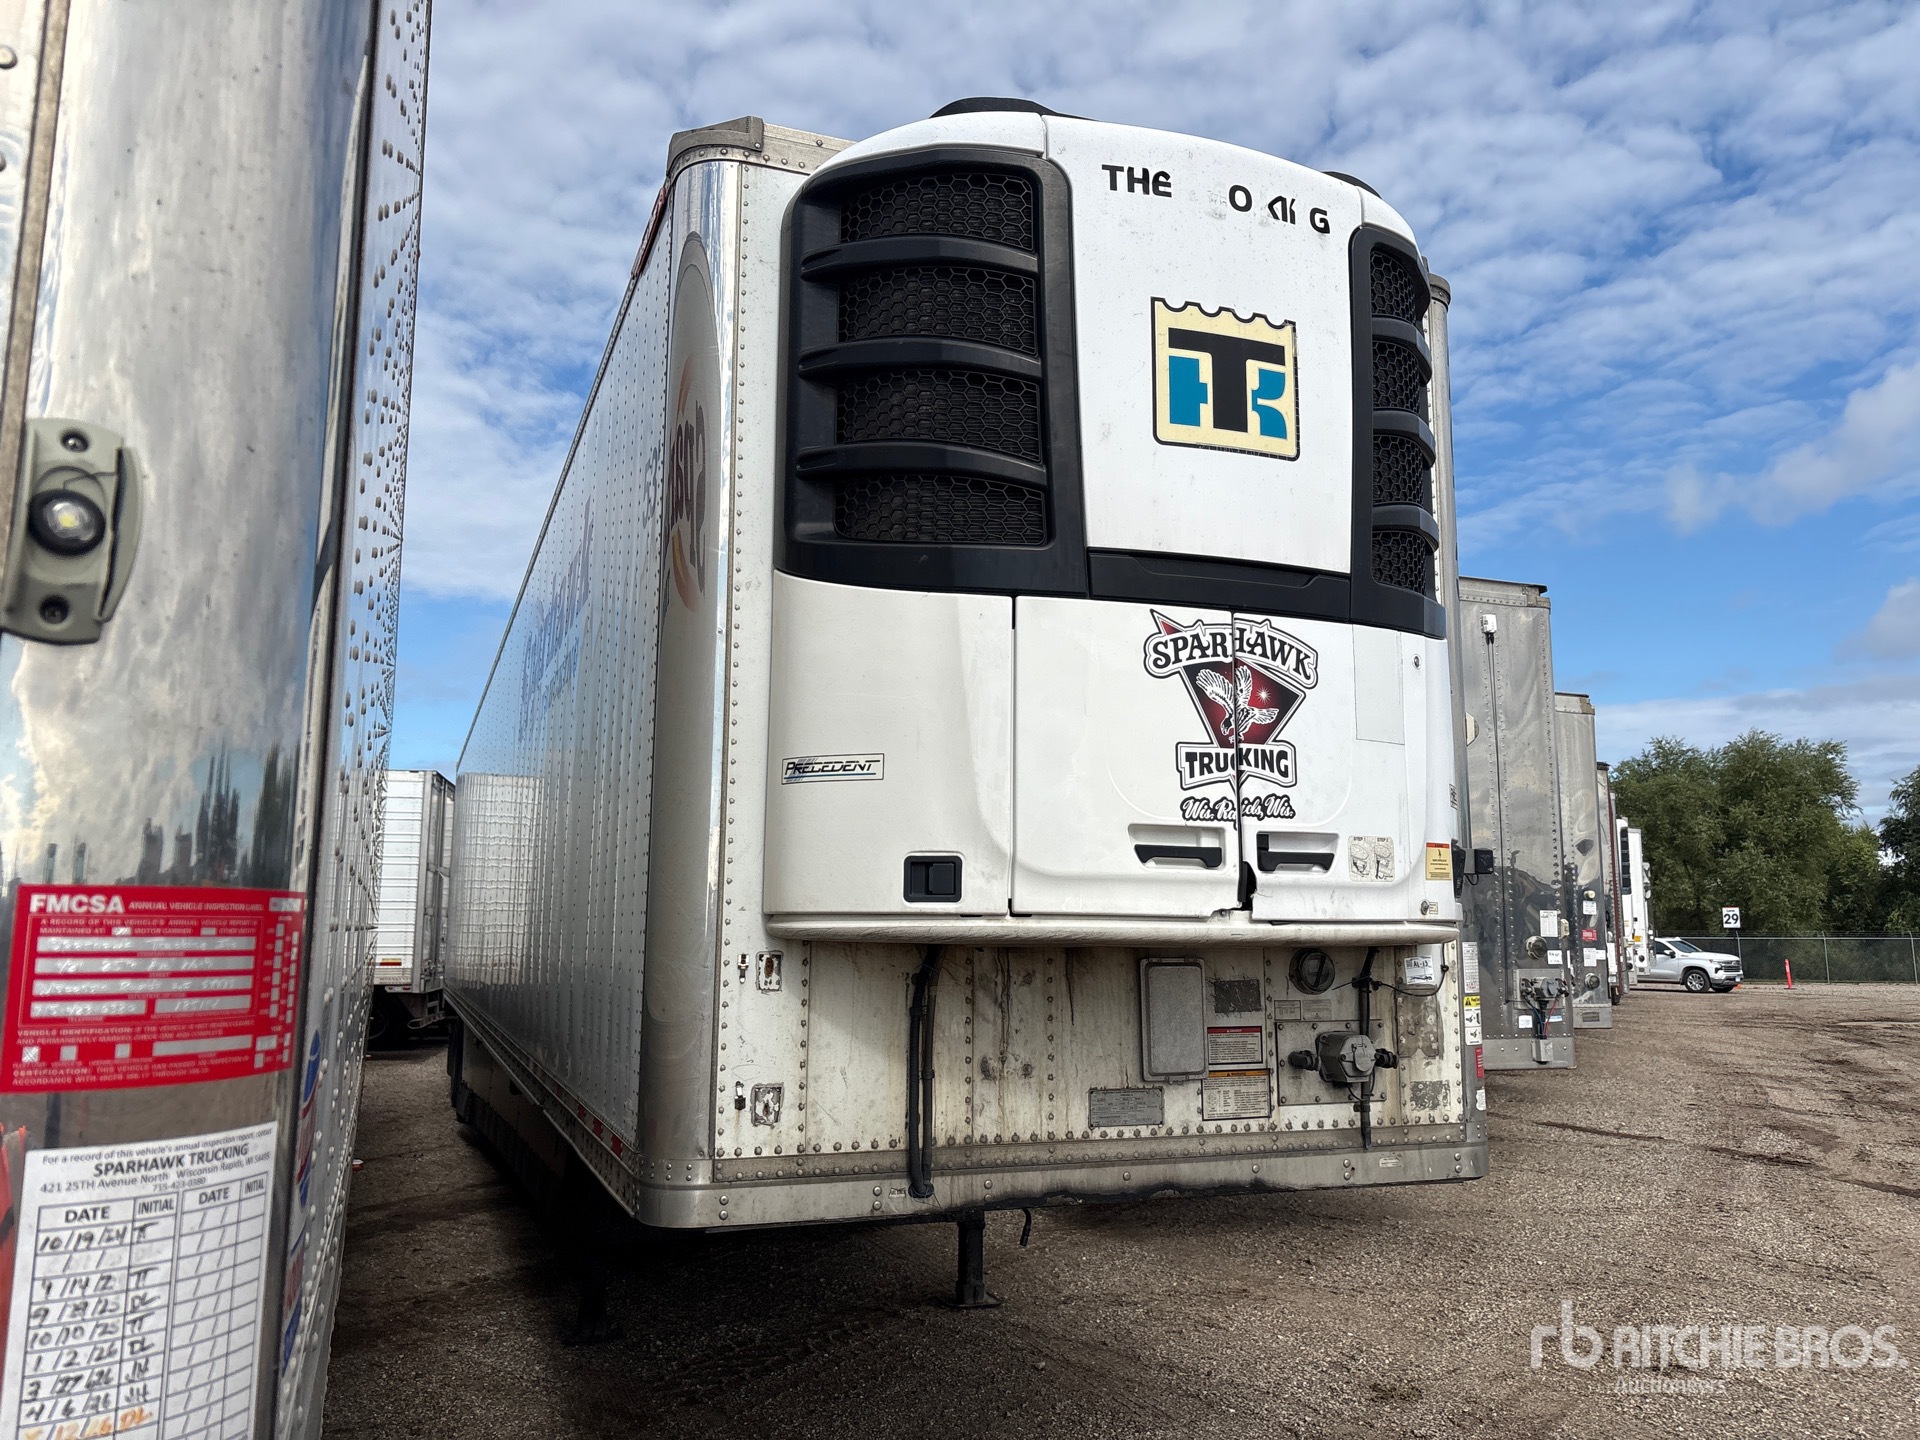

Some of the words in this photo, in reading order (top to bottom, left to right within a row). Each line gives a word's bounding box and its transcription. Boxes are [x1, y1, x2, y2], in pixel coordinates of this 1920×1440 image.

[1152, 626, 1311, 681] SPARHAWK
[785, 760, 881, 776] PRECEDENT
[1185, 747, 1289, 780] TRUCKING
[1182, 798, 1214, 821] Wis.
[1215, 797, 1263, 823] Raids,
[1264, 795, 1296, 818] Wis.
[29, 893, 125, 914] FMCSA
[128, 902, 167, 911] ANNUAL
[169, 902, 202, 911] VEHICLE
[1724, 913, 1739, 925] 29
[42, 1155, 59, 1164] For
[70, 1152, 103, 1162] record
[104, 1150, 115, 1159] of
[117, 1149, 133, 1158] this
[136, 1145, 172, 1156] vehicle's
[174, 1142, 201, 1152] annual
[202, 1136, 236, 1148] inspection
[93, 1154, 186, 1178] SPARHAWK
[189, 1143, 249, 1166] TRUCKING
[40, 1183, 62, 1194] 421
[65, 1180, 95, 1192] 25TH
[97, 1177, 138, 1189] Avenue
[140, 1173, 169, 1184] North
[176, 1164, 218, 1180] Wisconsin
[64, 1206, 111, 1223] DATE
[137, 1197, 175, 1215] INITIAL
[198, 1187, 230, 1205] DATE
[244, 1178, 264, 1194] INITIAL
